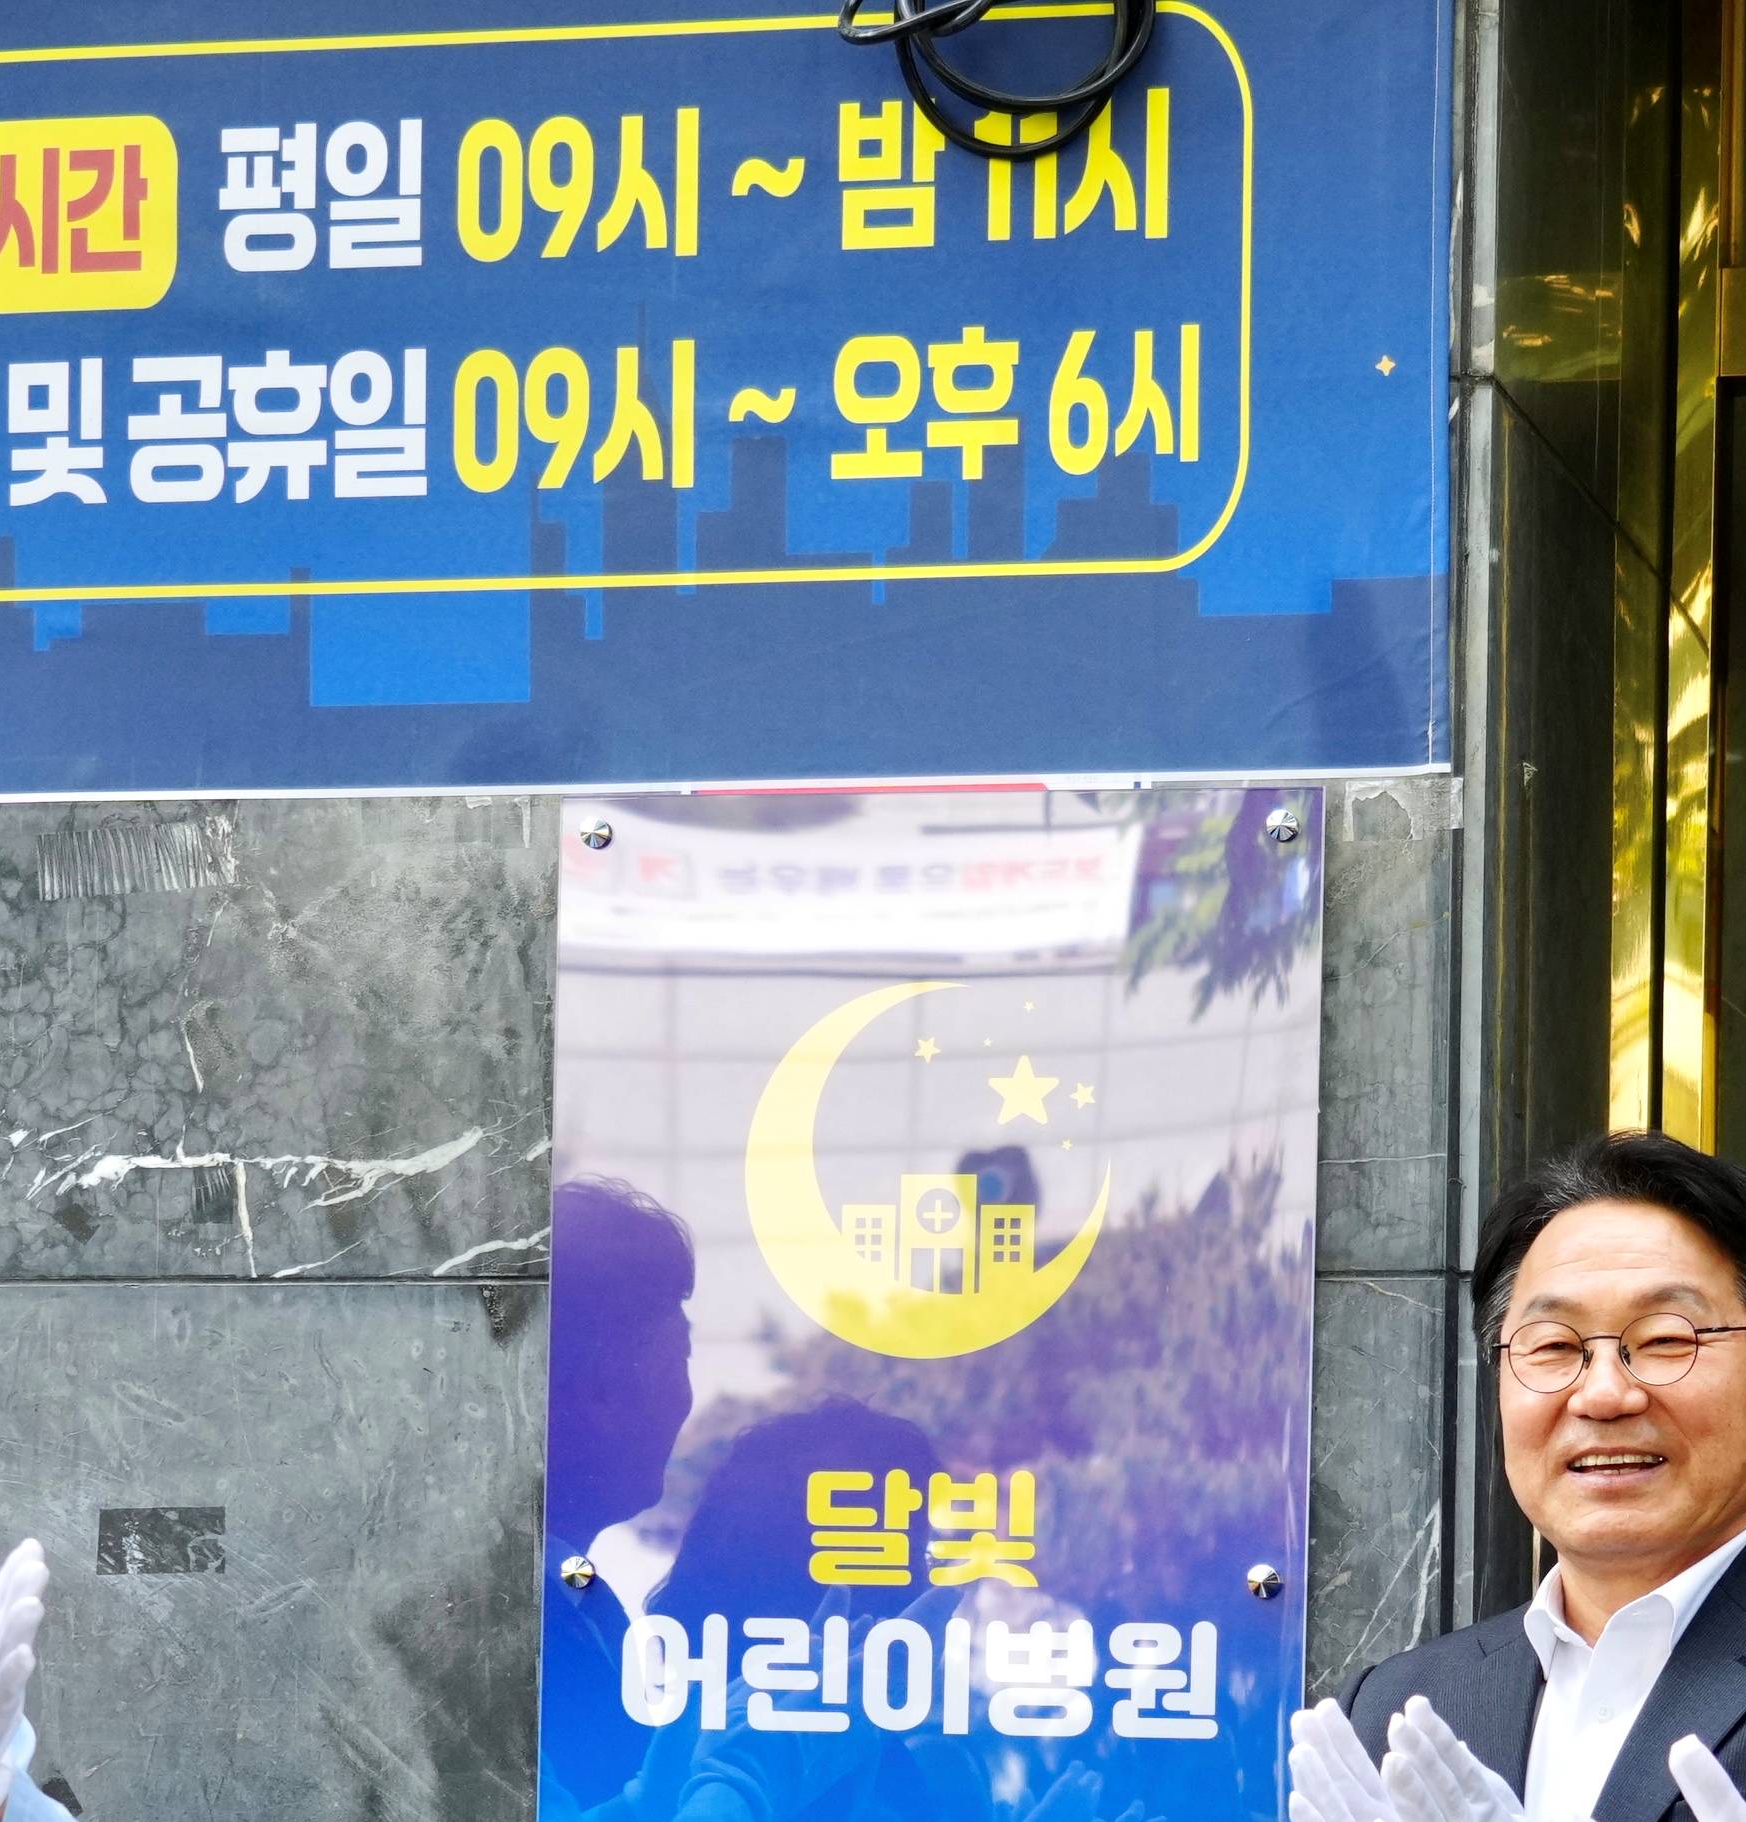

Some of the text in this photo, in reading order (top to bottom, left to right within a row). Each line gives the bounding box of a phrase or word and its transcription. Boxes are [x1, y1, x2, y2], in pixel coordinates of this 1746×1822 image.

[218, 117, 423, 272] 평일
[458, 106, 699, 260] 09시
[838, 98, 946, 250] 밤
[973, 86, 1170, 241] 11시
[7, 356, 108, 507] 및
[127, 347, 428, 504] 공휴일
[455, 338, 693, 491] 09시
[830, 325, 1019, 482] 오후
[1050, 325, 1199, 474] 6시
[806, 1468, 1038, 1588] 달빛
[621, 1613, 1219, 1739] 어린이병원
